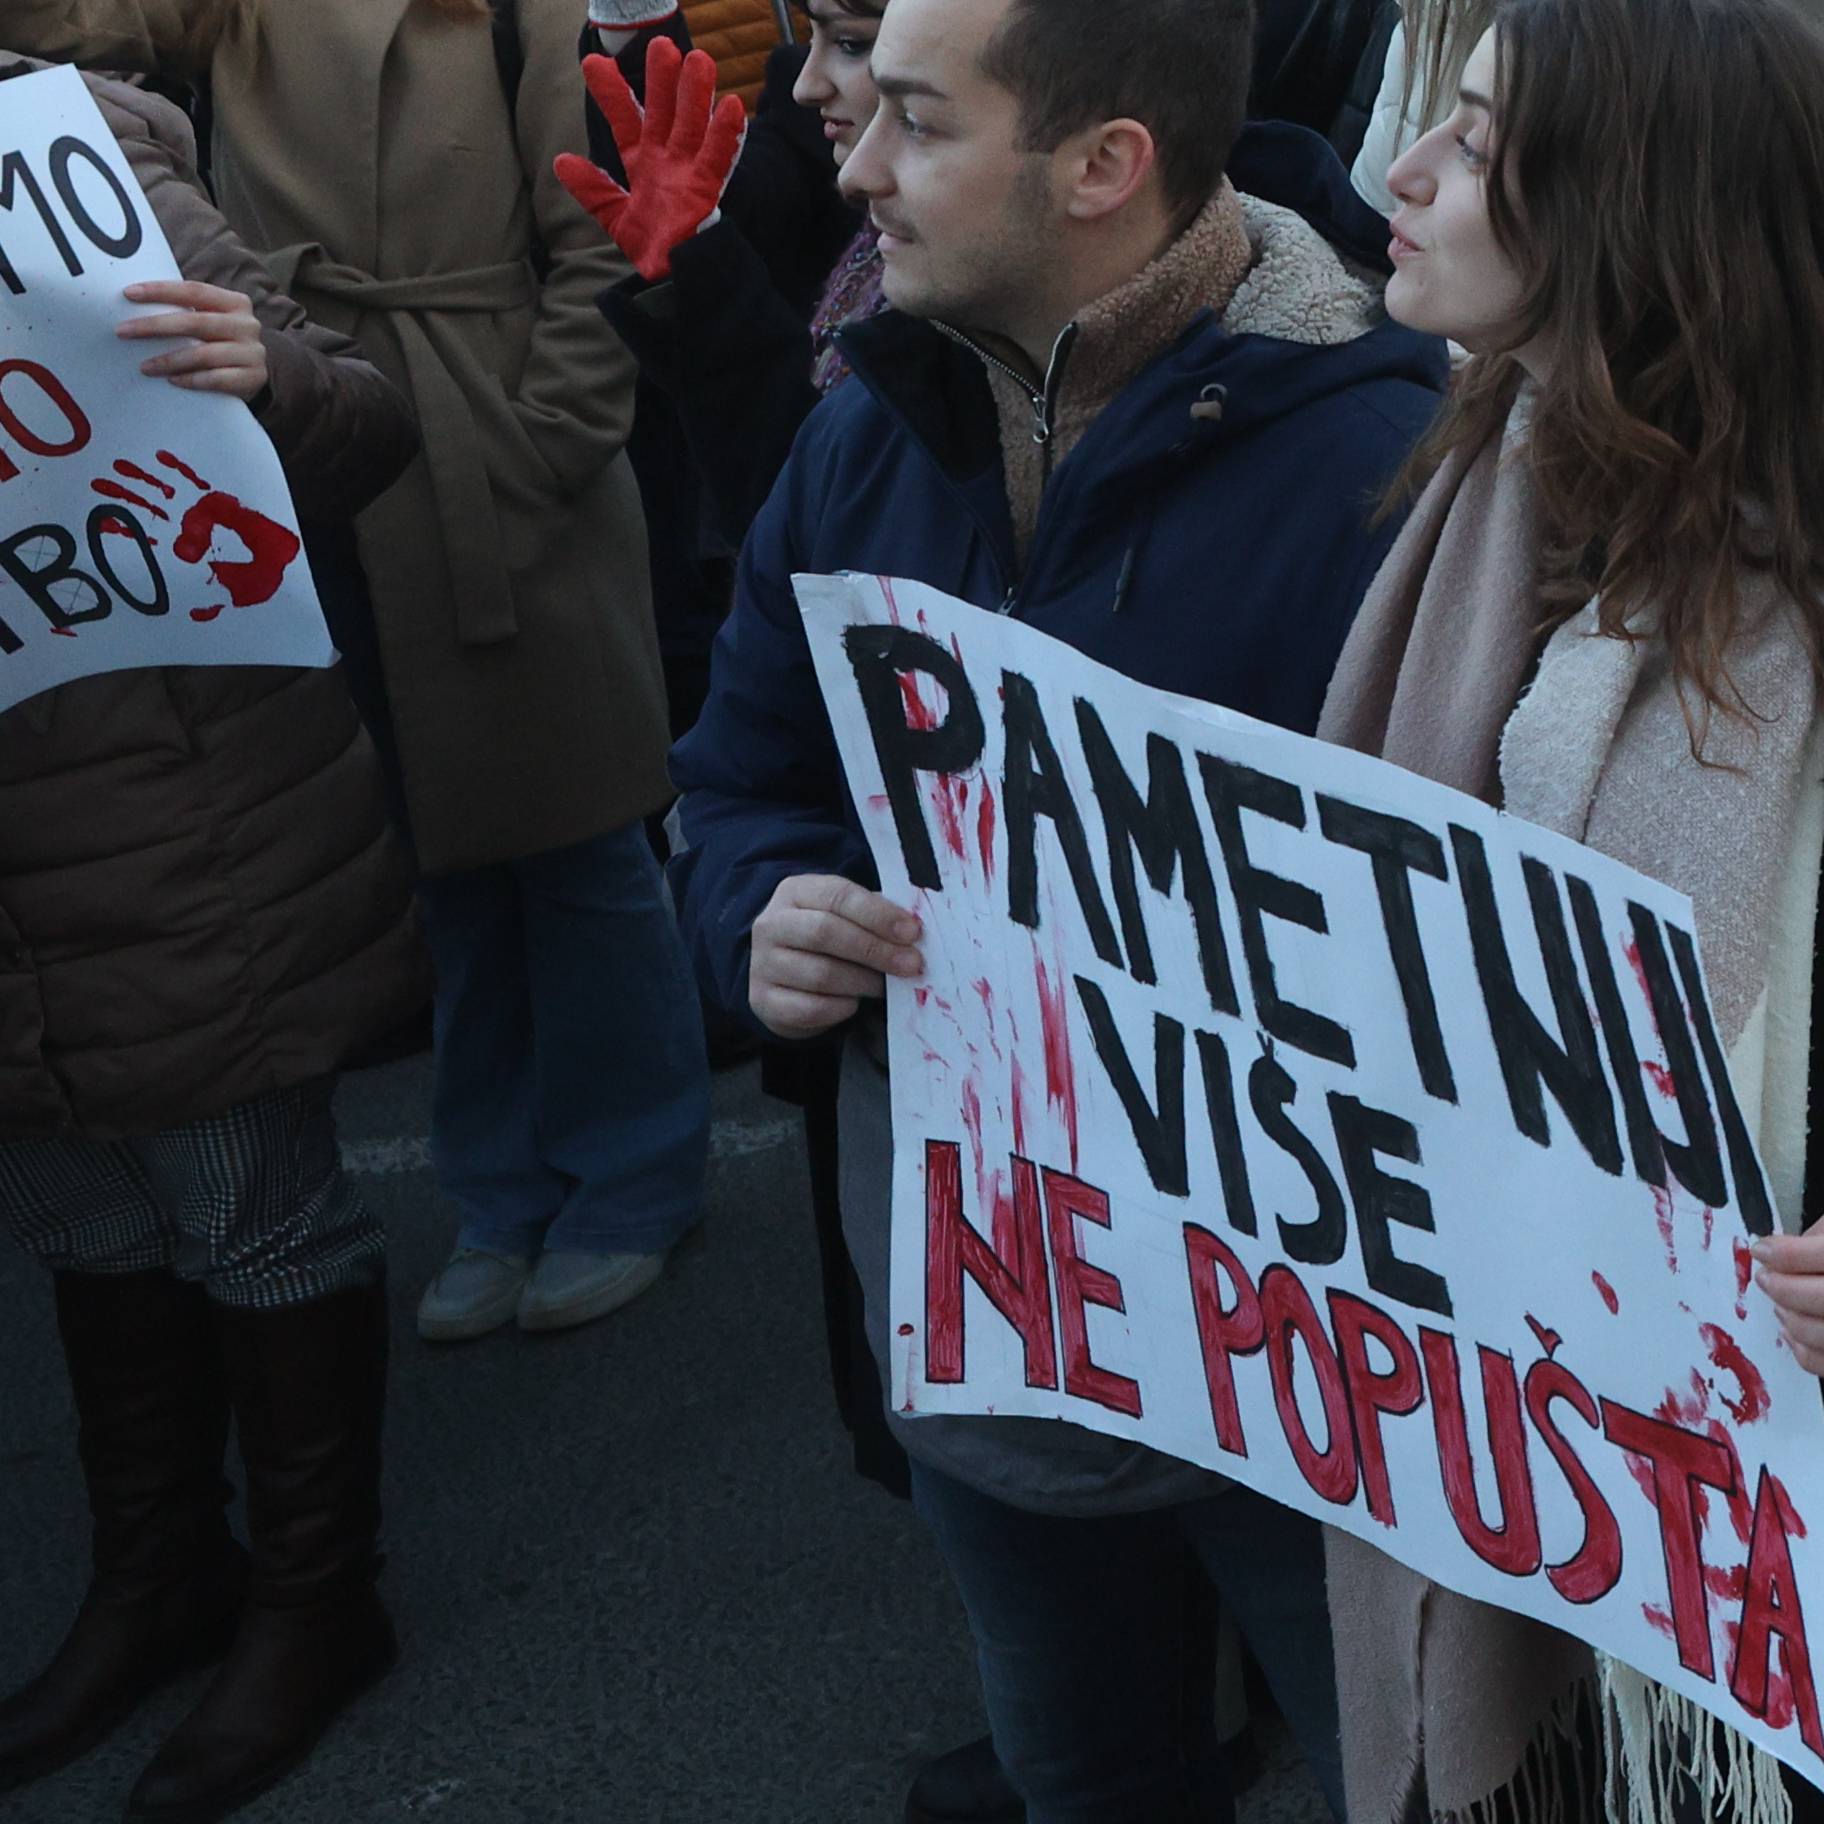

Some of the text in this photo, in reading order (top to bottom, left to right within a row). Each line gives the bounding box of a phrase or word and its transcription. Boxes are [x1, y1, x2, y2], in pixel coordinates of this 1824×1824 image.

[842, 622, 1775, 1236] PAMETNIJI
[923, 1136, 1142, 1419] NE
[1074, 974, 1453, 1319] VIŠE
